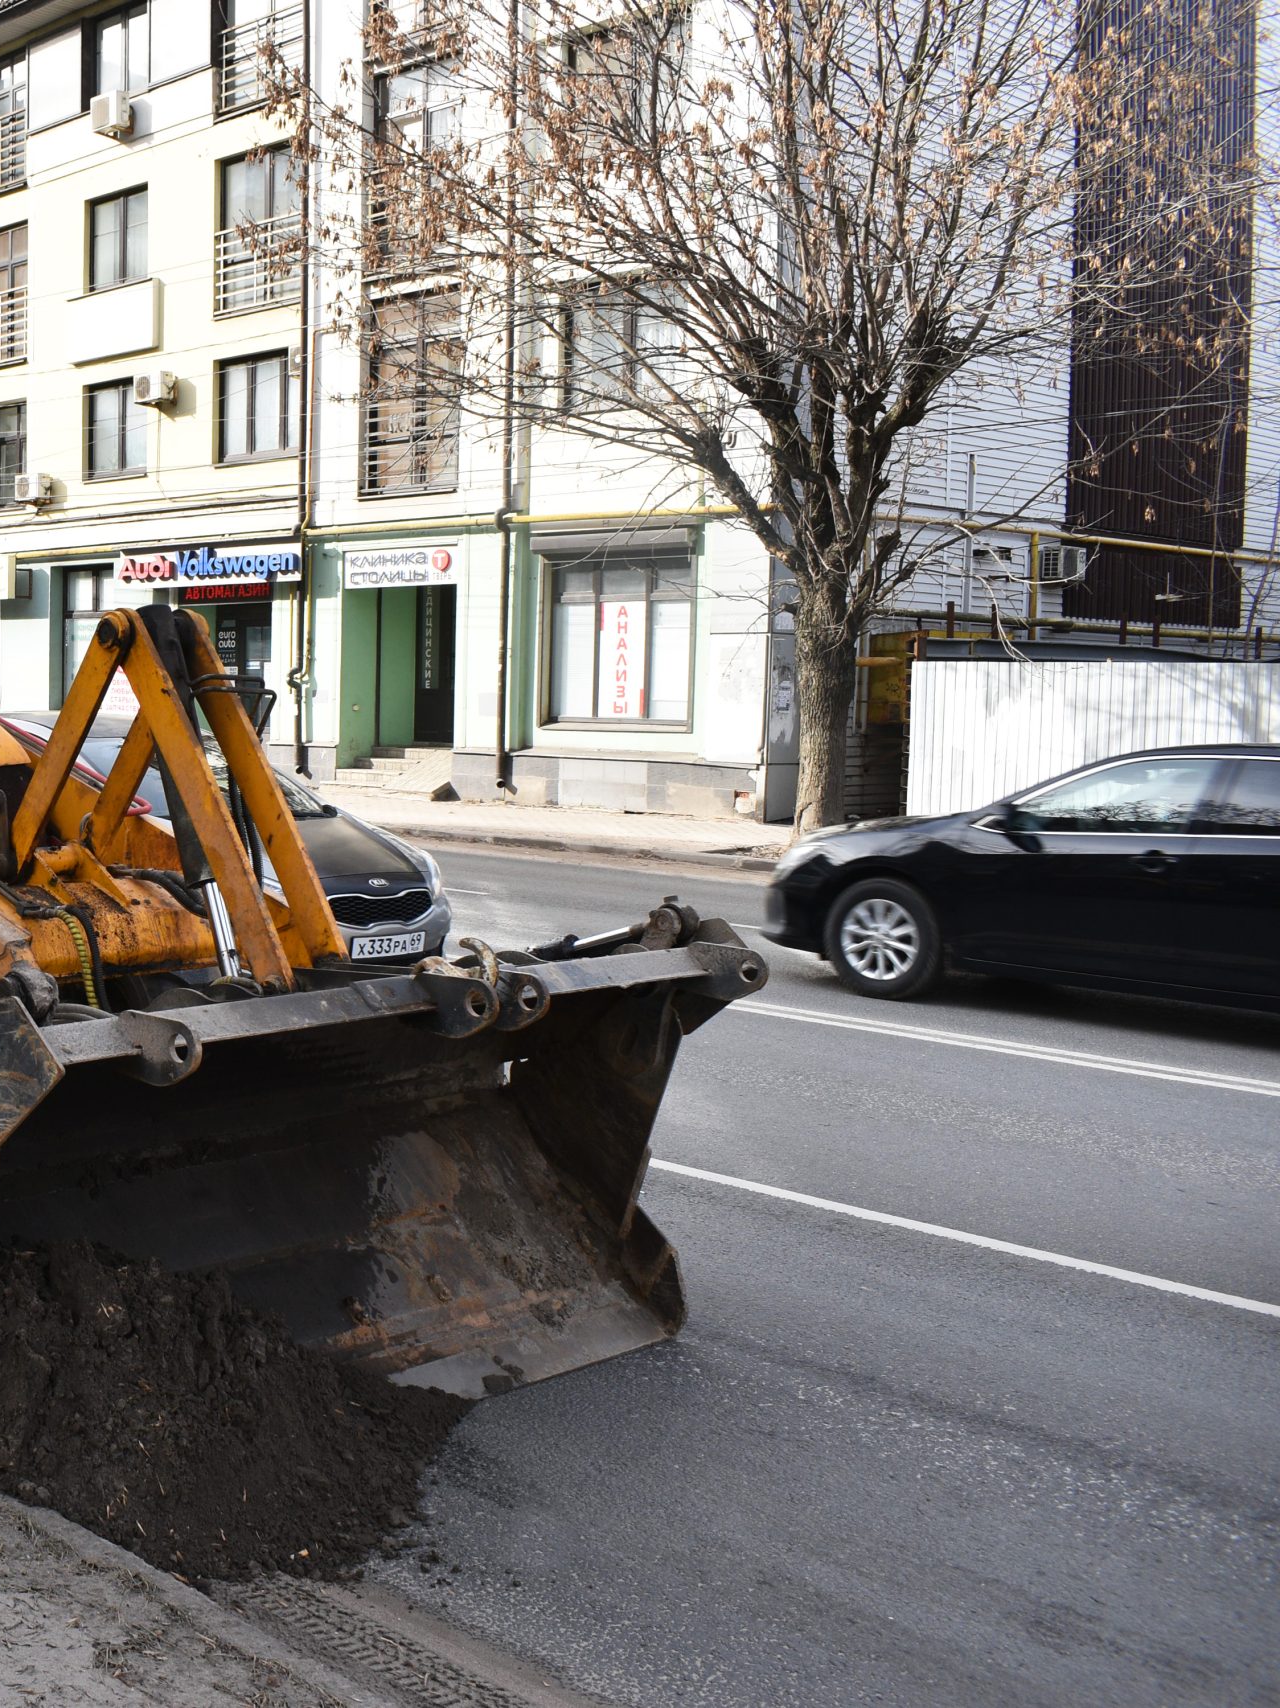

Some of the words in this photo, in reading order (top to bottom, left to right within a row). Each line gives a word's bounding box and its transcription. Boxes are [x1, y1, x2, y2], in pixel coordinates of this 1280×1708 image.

[118, 554, 171, 583] Audi
[175, 546, 295, 581] Volkswagen
[218, 631, 236, 639] euro
[218, 639, 236, 648] auto
[424, 586, 432, 689] ЕДИЦИНСКИЕ
[613, 605, 628, 714] АНАЛИЗЫ
[410, 934, 422, 946] 69
